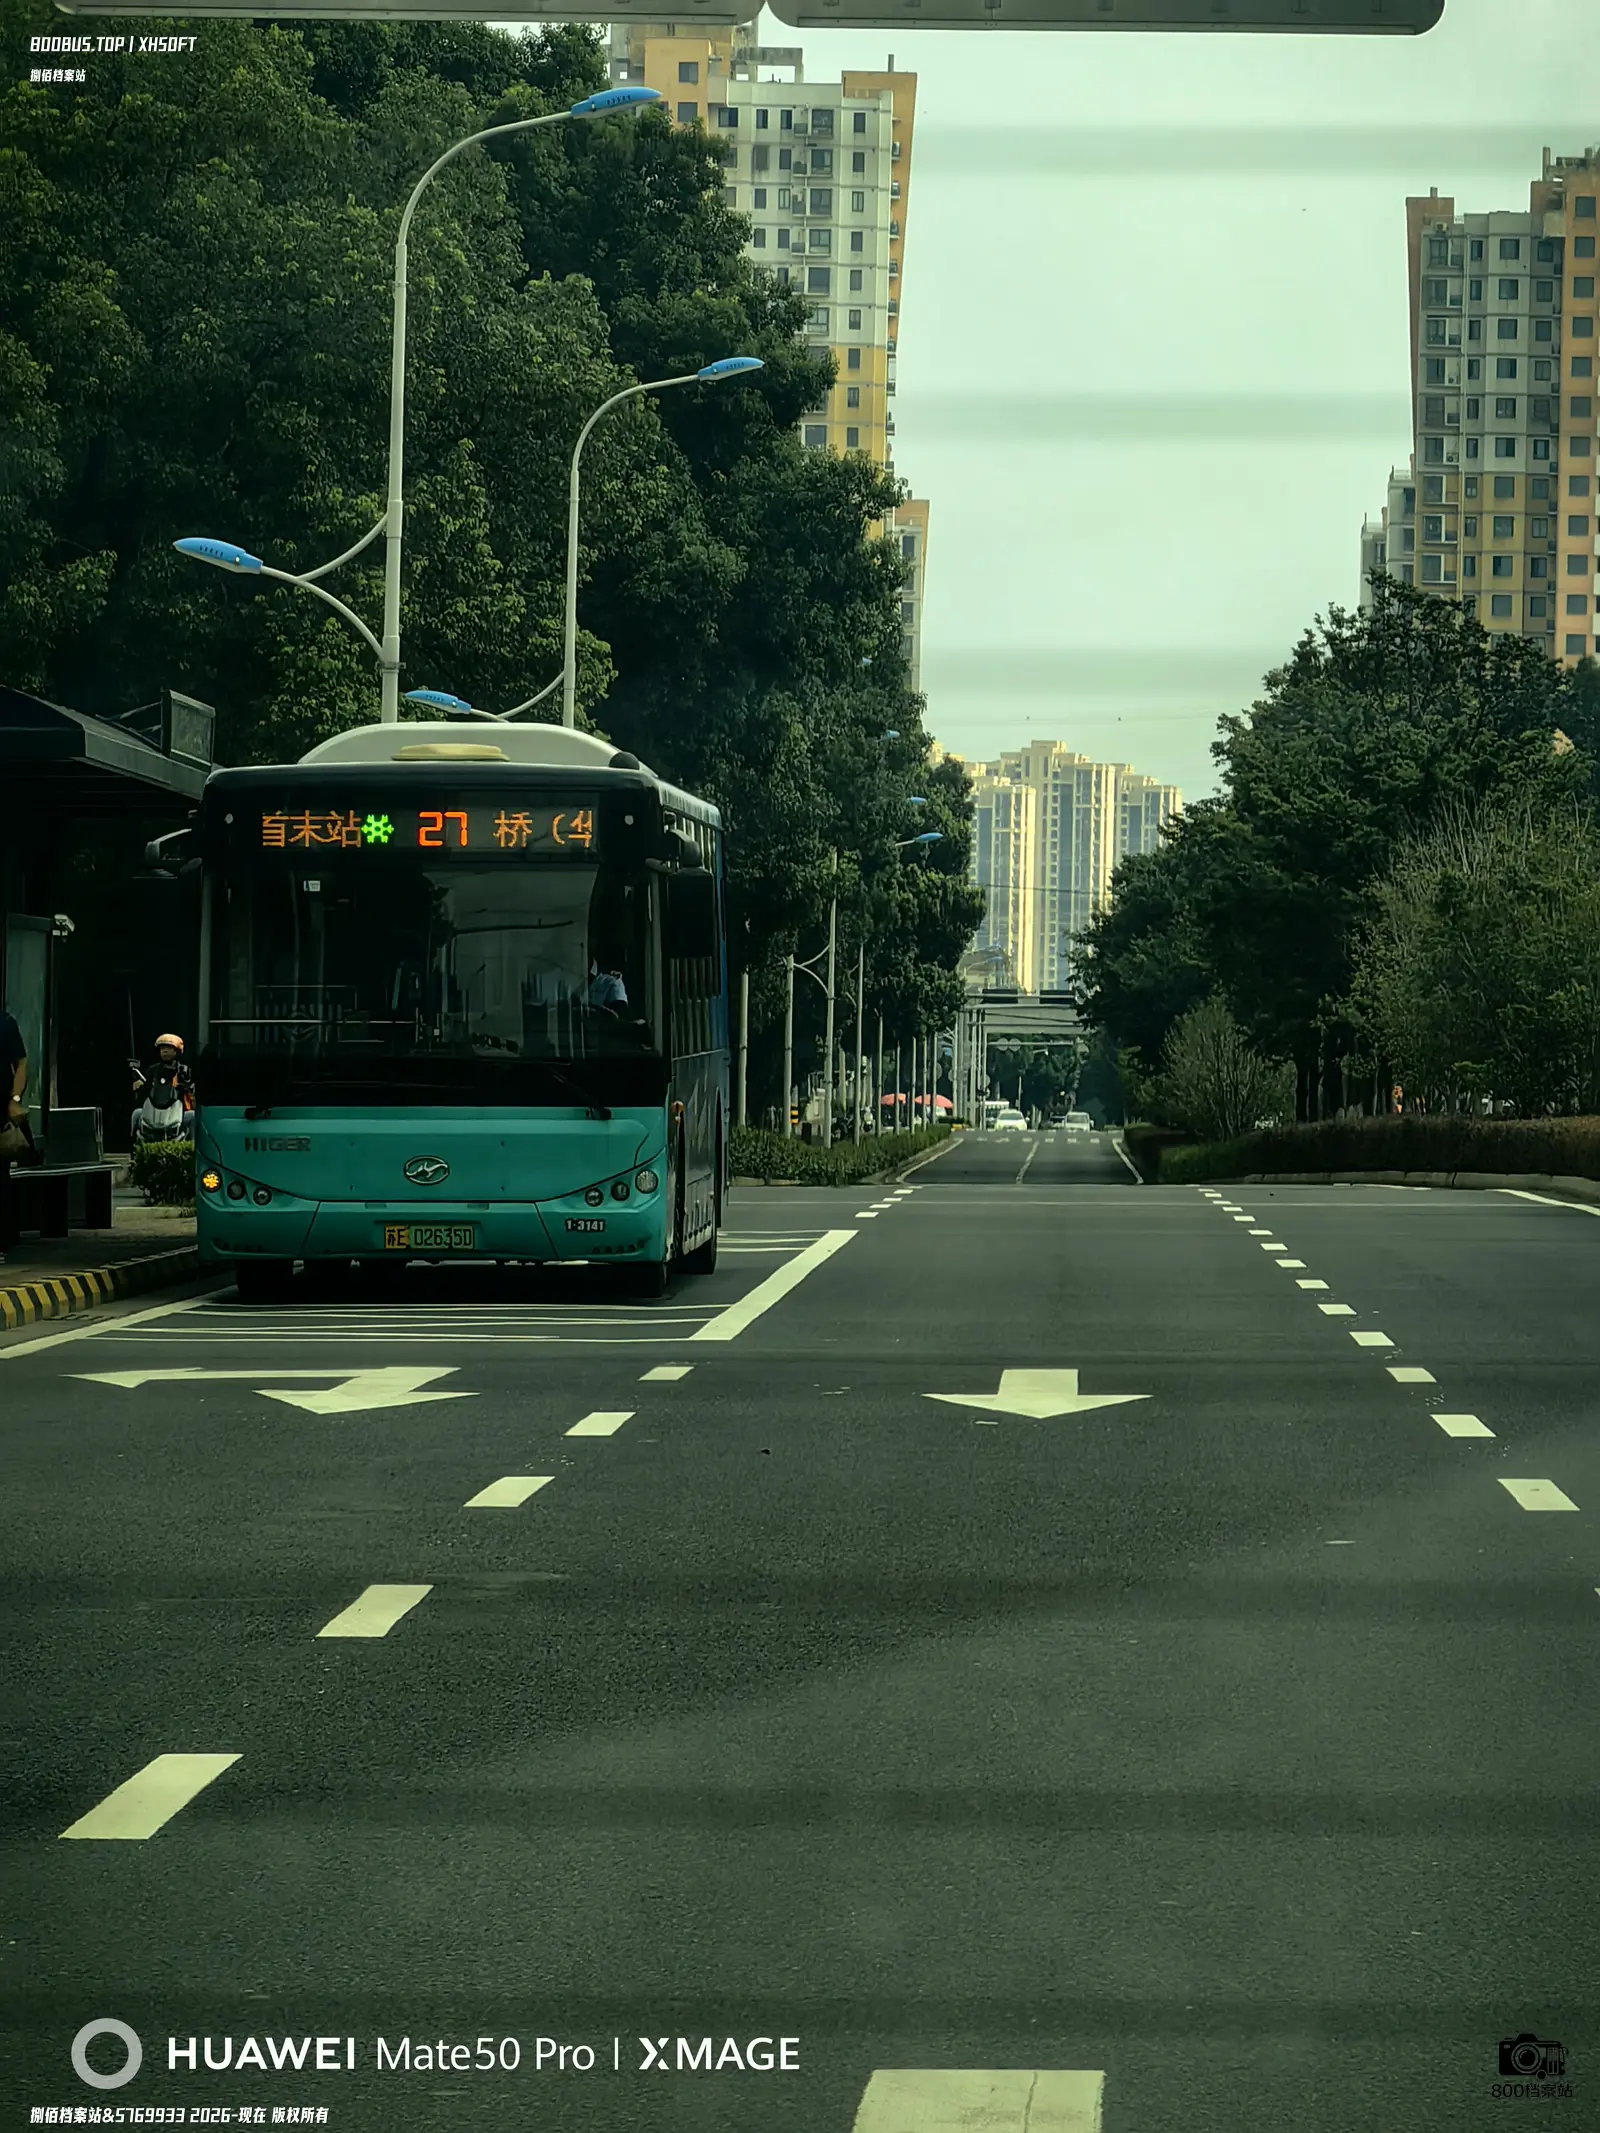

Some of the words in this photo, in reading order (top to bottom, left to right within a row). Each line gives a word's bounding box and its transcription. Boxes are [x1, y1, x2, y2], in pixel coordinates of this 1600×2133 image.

[262, 809, 362, 848] 首末站
[418, 811, 468, 848] 27
[243, 1135, 312, 1152] HIGER
